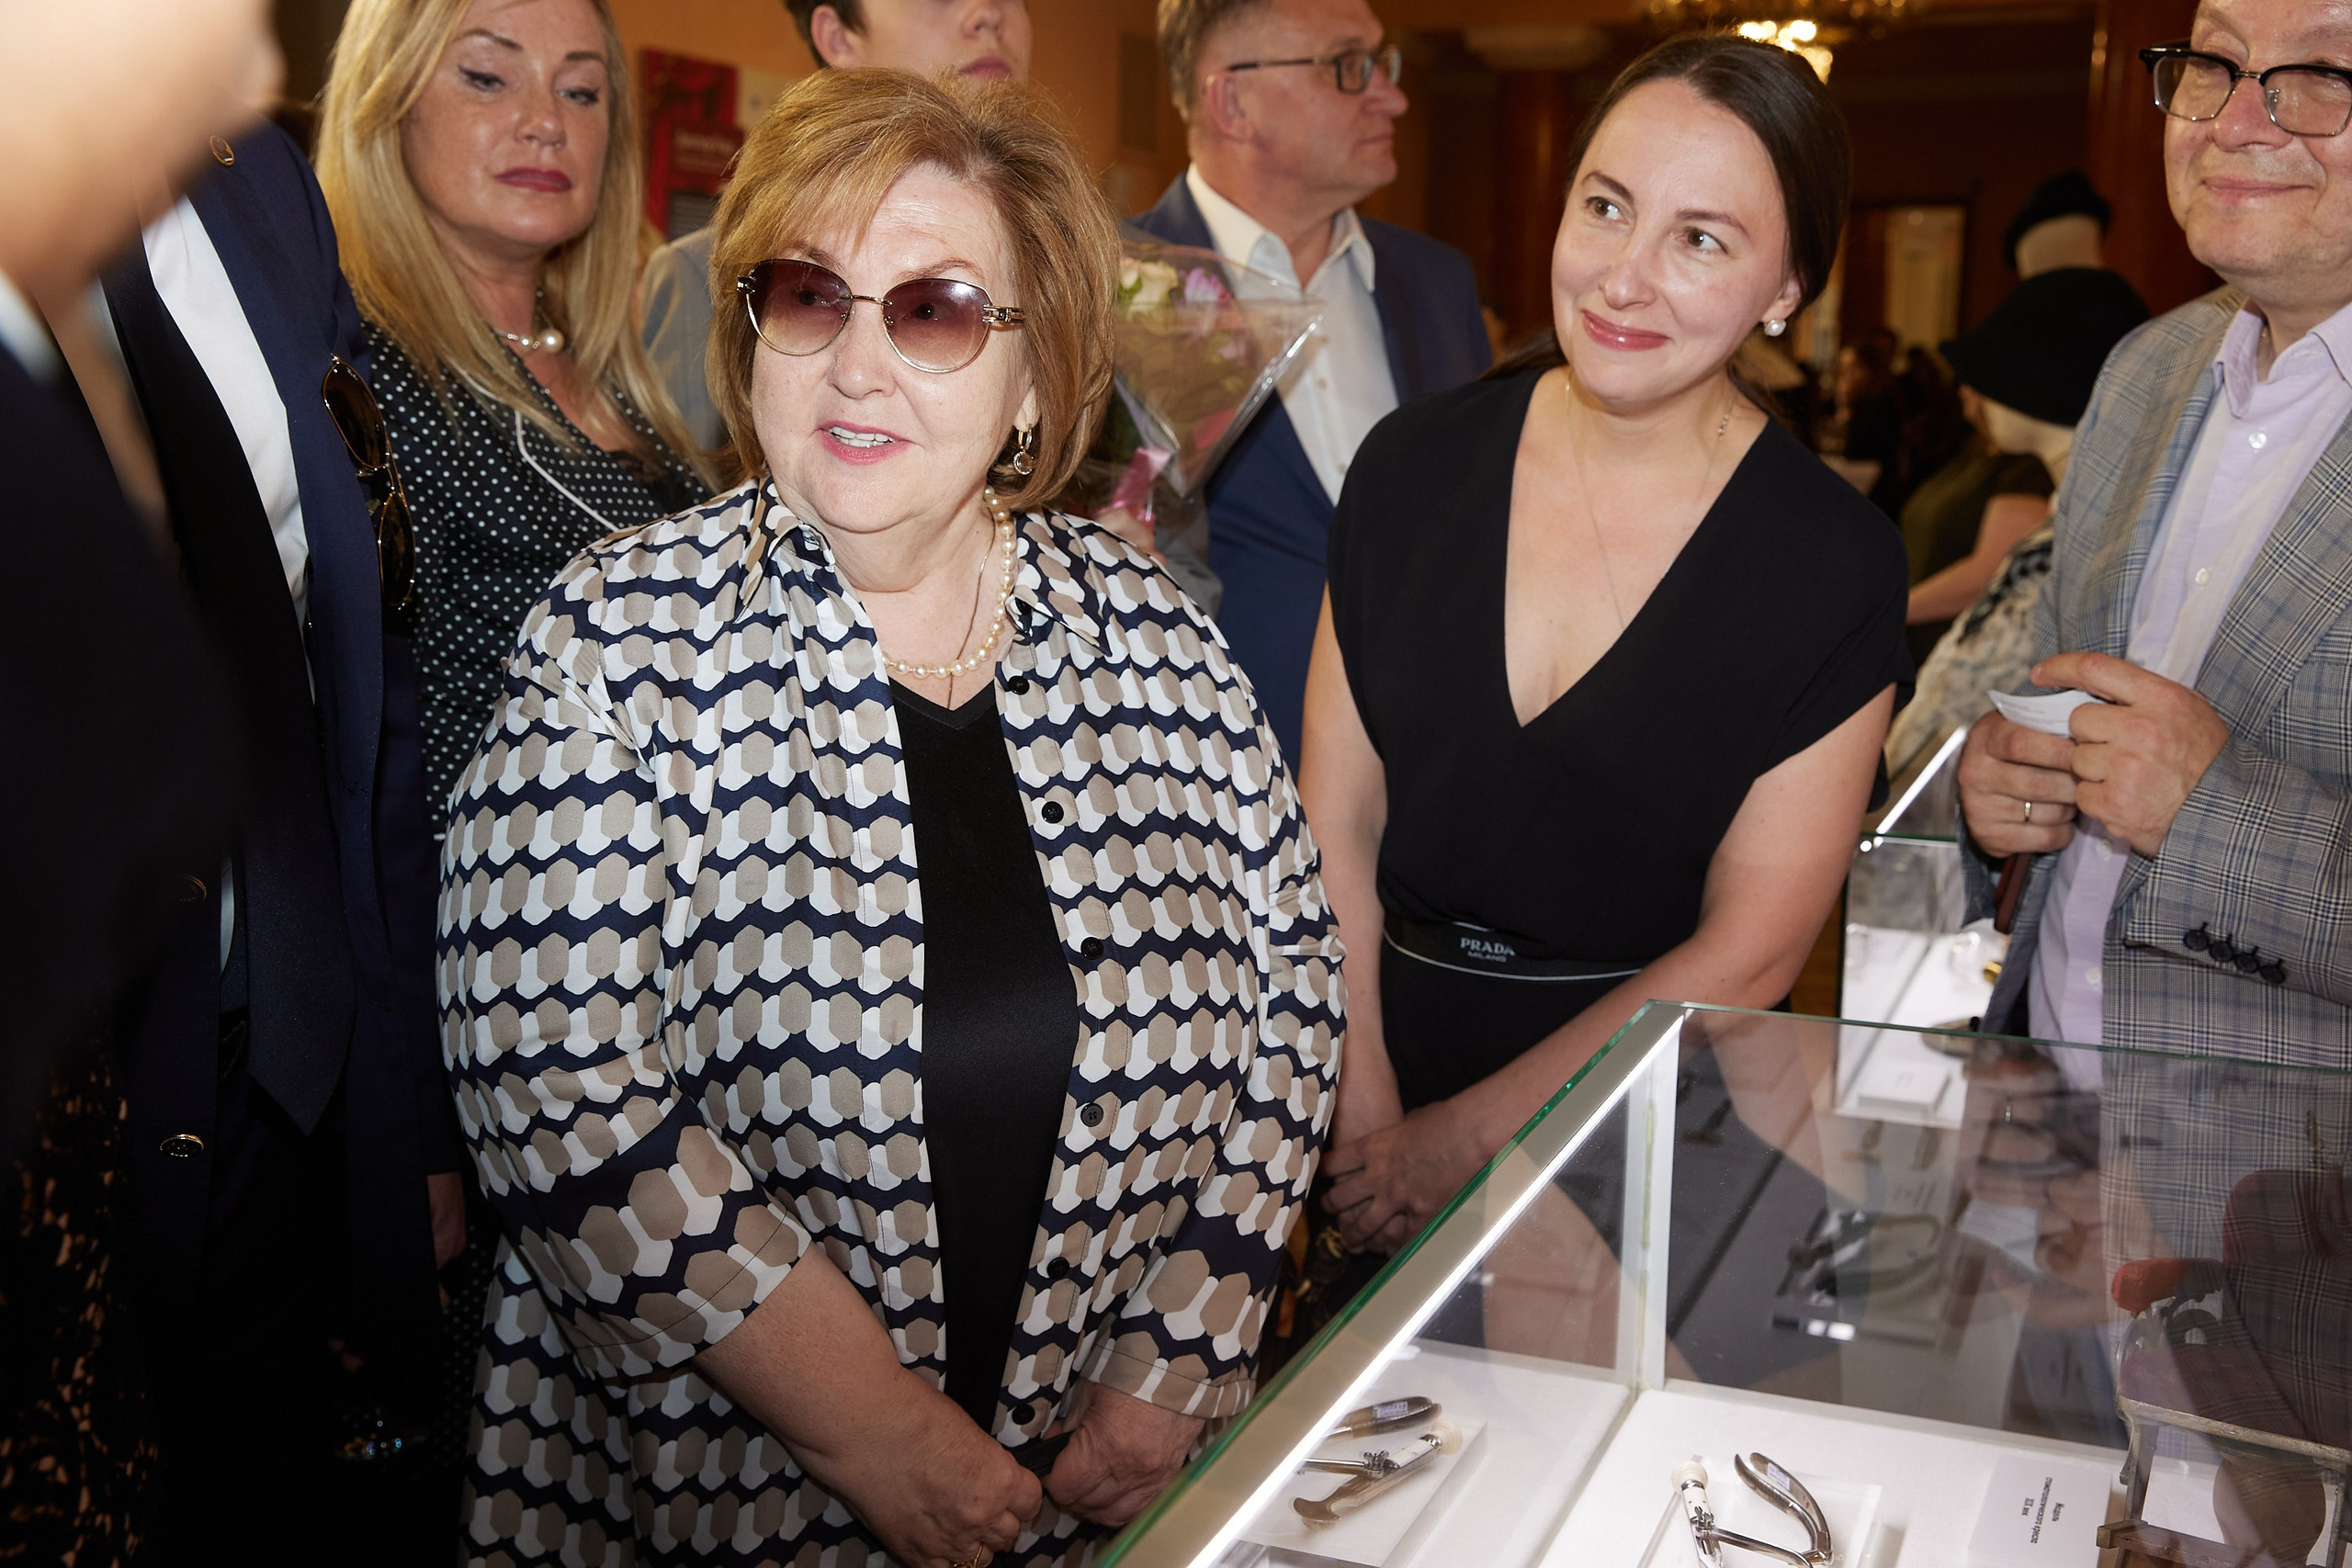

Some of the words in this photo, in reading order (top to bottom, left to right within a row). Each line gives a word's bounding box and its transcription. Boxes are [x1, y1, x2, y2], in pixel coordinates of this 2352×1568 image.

[1460, 937, 1516, 956] PRADA
[1467, 951, 1507, 963] MILANO
[2035, 1477, 2052, 1525] стоматологического
[2021, 1507, 2030, 1516] век
[2052, 1503, 2064, 1521] Модель
[2030, 1526, 2041, 1543] кресла
